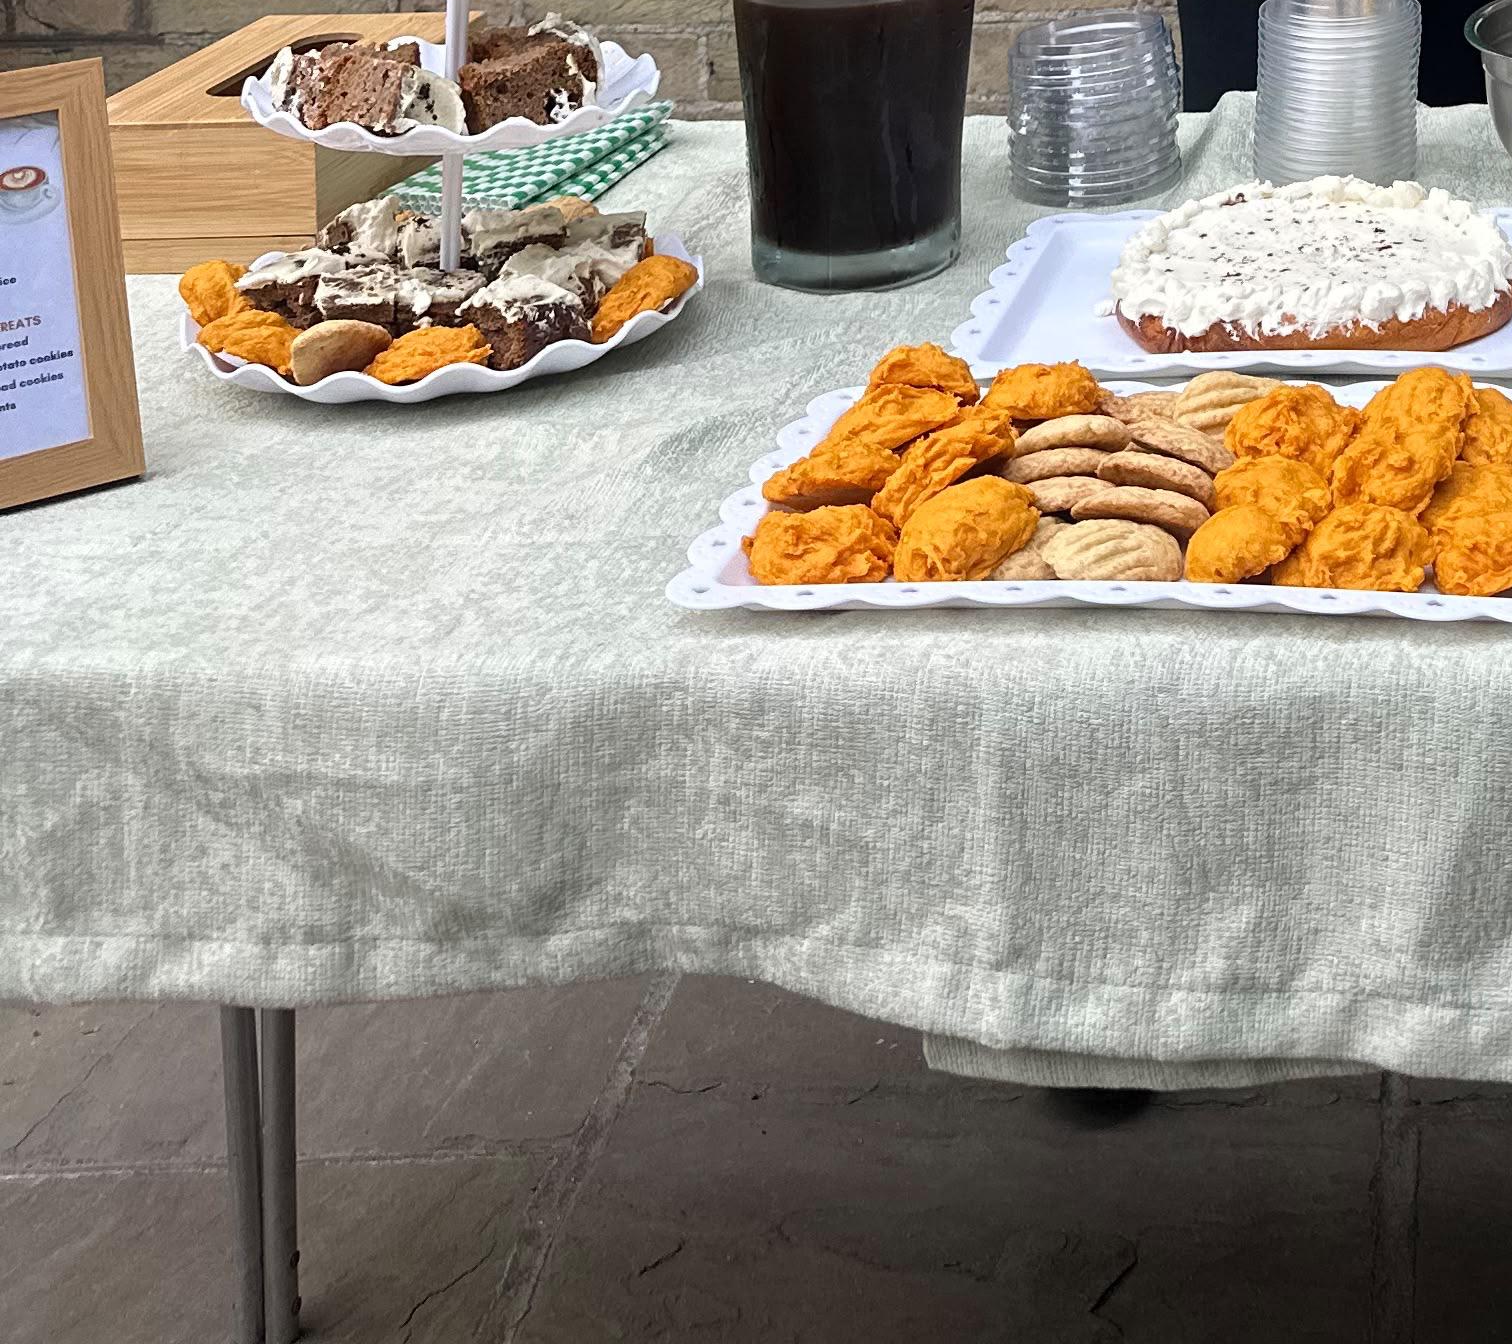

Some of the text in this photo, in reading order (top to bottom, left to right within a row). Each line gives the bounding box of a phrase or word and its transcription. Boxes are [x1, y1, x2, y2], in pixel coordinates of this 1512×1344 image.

[0, 335, 29, 351] read
[29, 350, 74, 365] cookies
[19, 372, 64, 388] cookies
